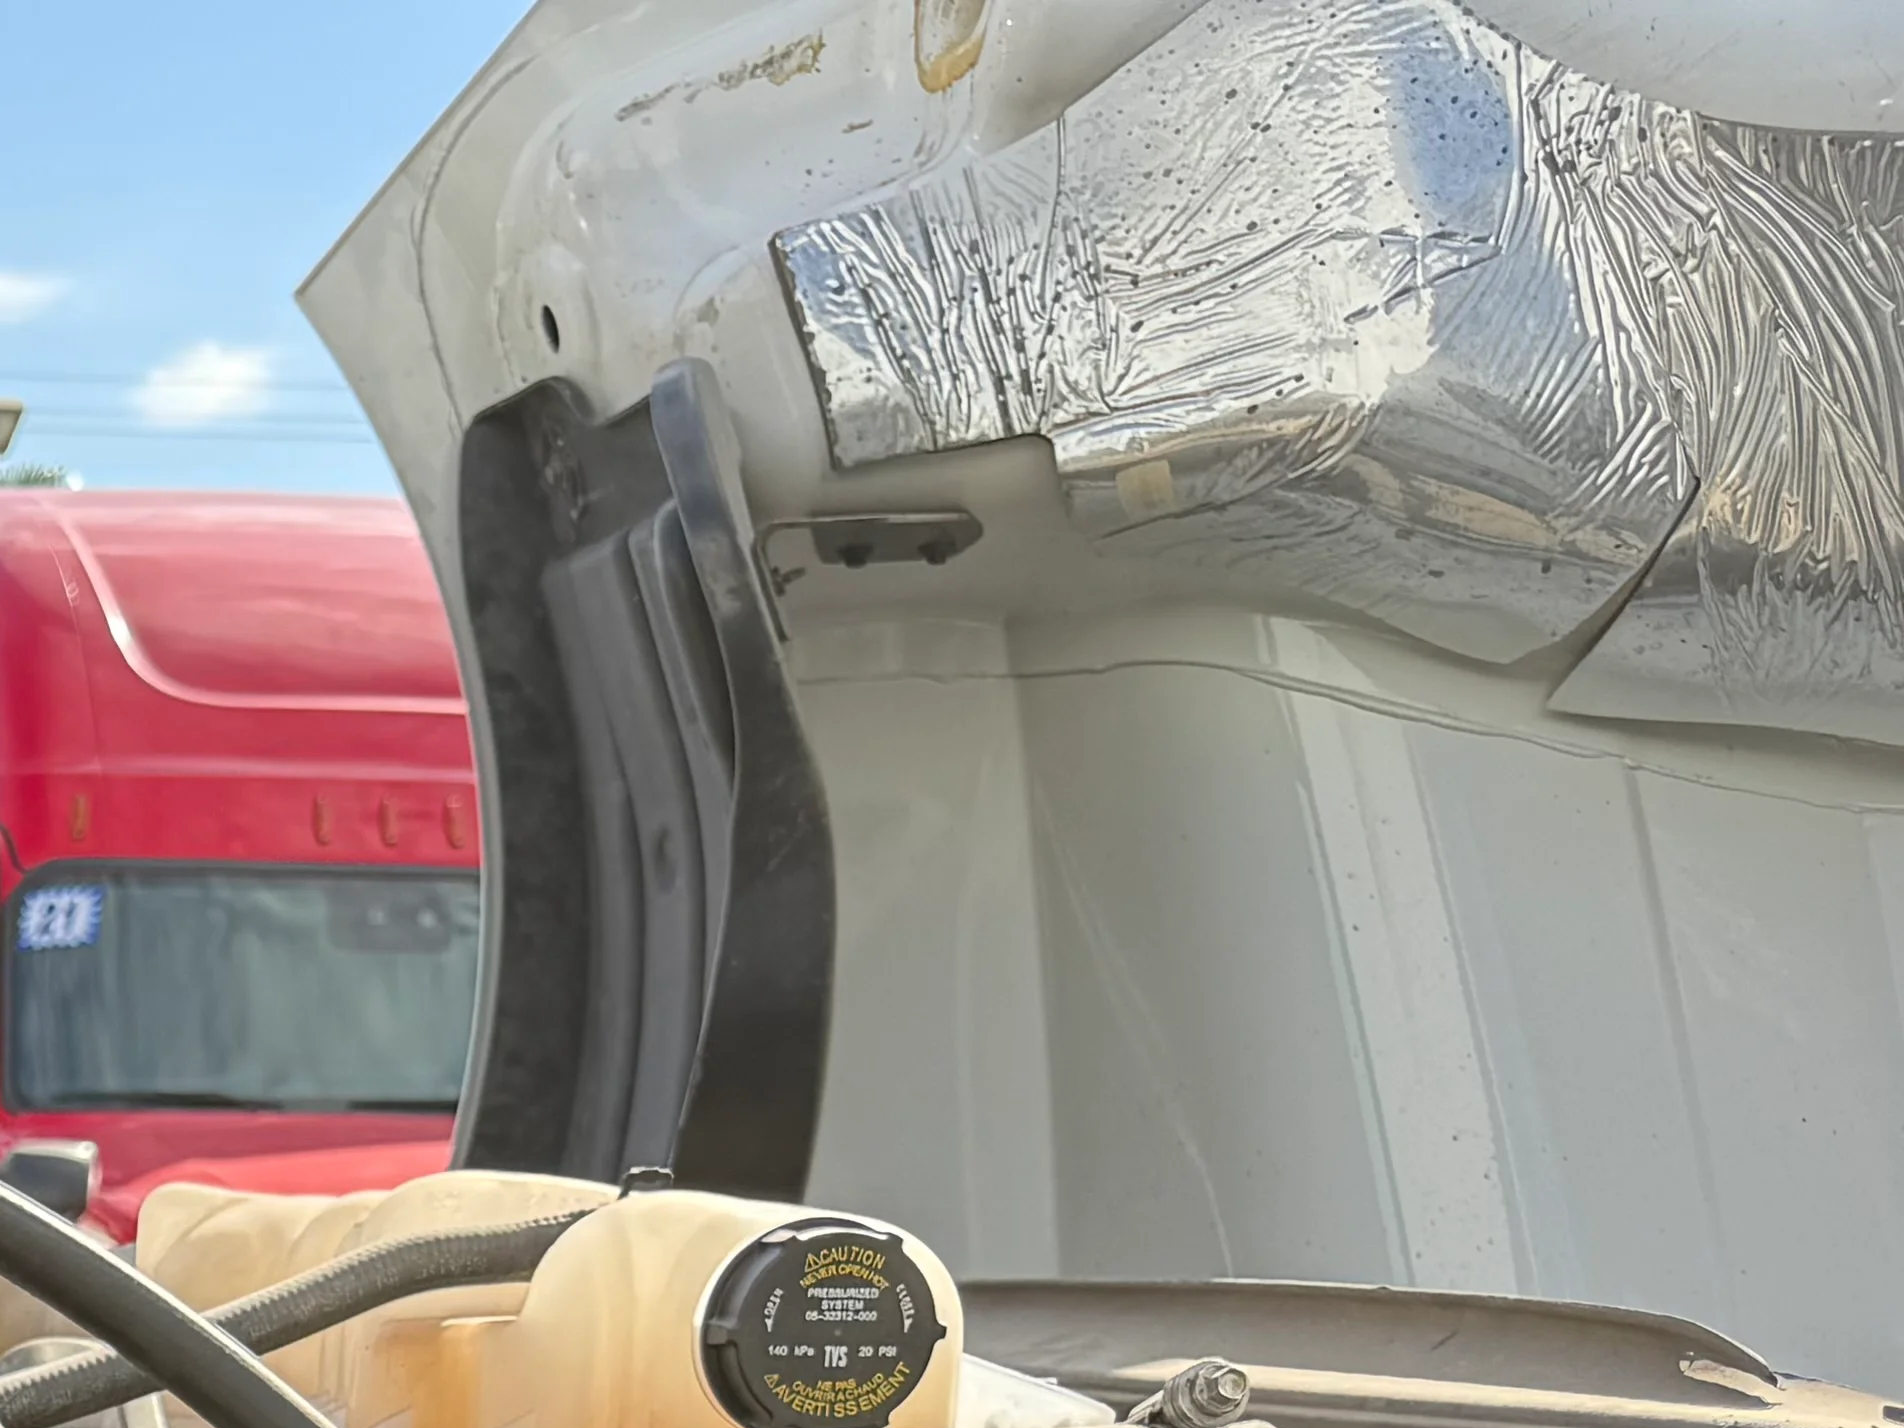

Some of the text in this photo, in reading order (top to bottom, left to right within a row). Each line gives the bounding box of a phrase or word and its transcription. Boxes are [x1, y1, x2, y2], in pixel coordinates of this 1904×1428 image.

[820, 1245, 886, 1270] CAUTION
[799, 1265, 837, 1288] NEVER
[838, 1263, 870, 1280] OPEN
[807, 1287, 880, 1298] PRESSURIZED
[821, 1299, 864, 1310] SYSTEM
[768, 1344, 788, 1356] 140
[858, 1346, 897, 1357] 20 PSI
[824, 1345, 848, 1368] TVS
[834, 1378, 857, 1390] PAS
[845, 1373, 884, 1401] CHAUD
